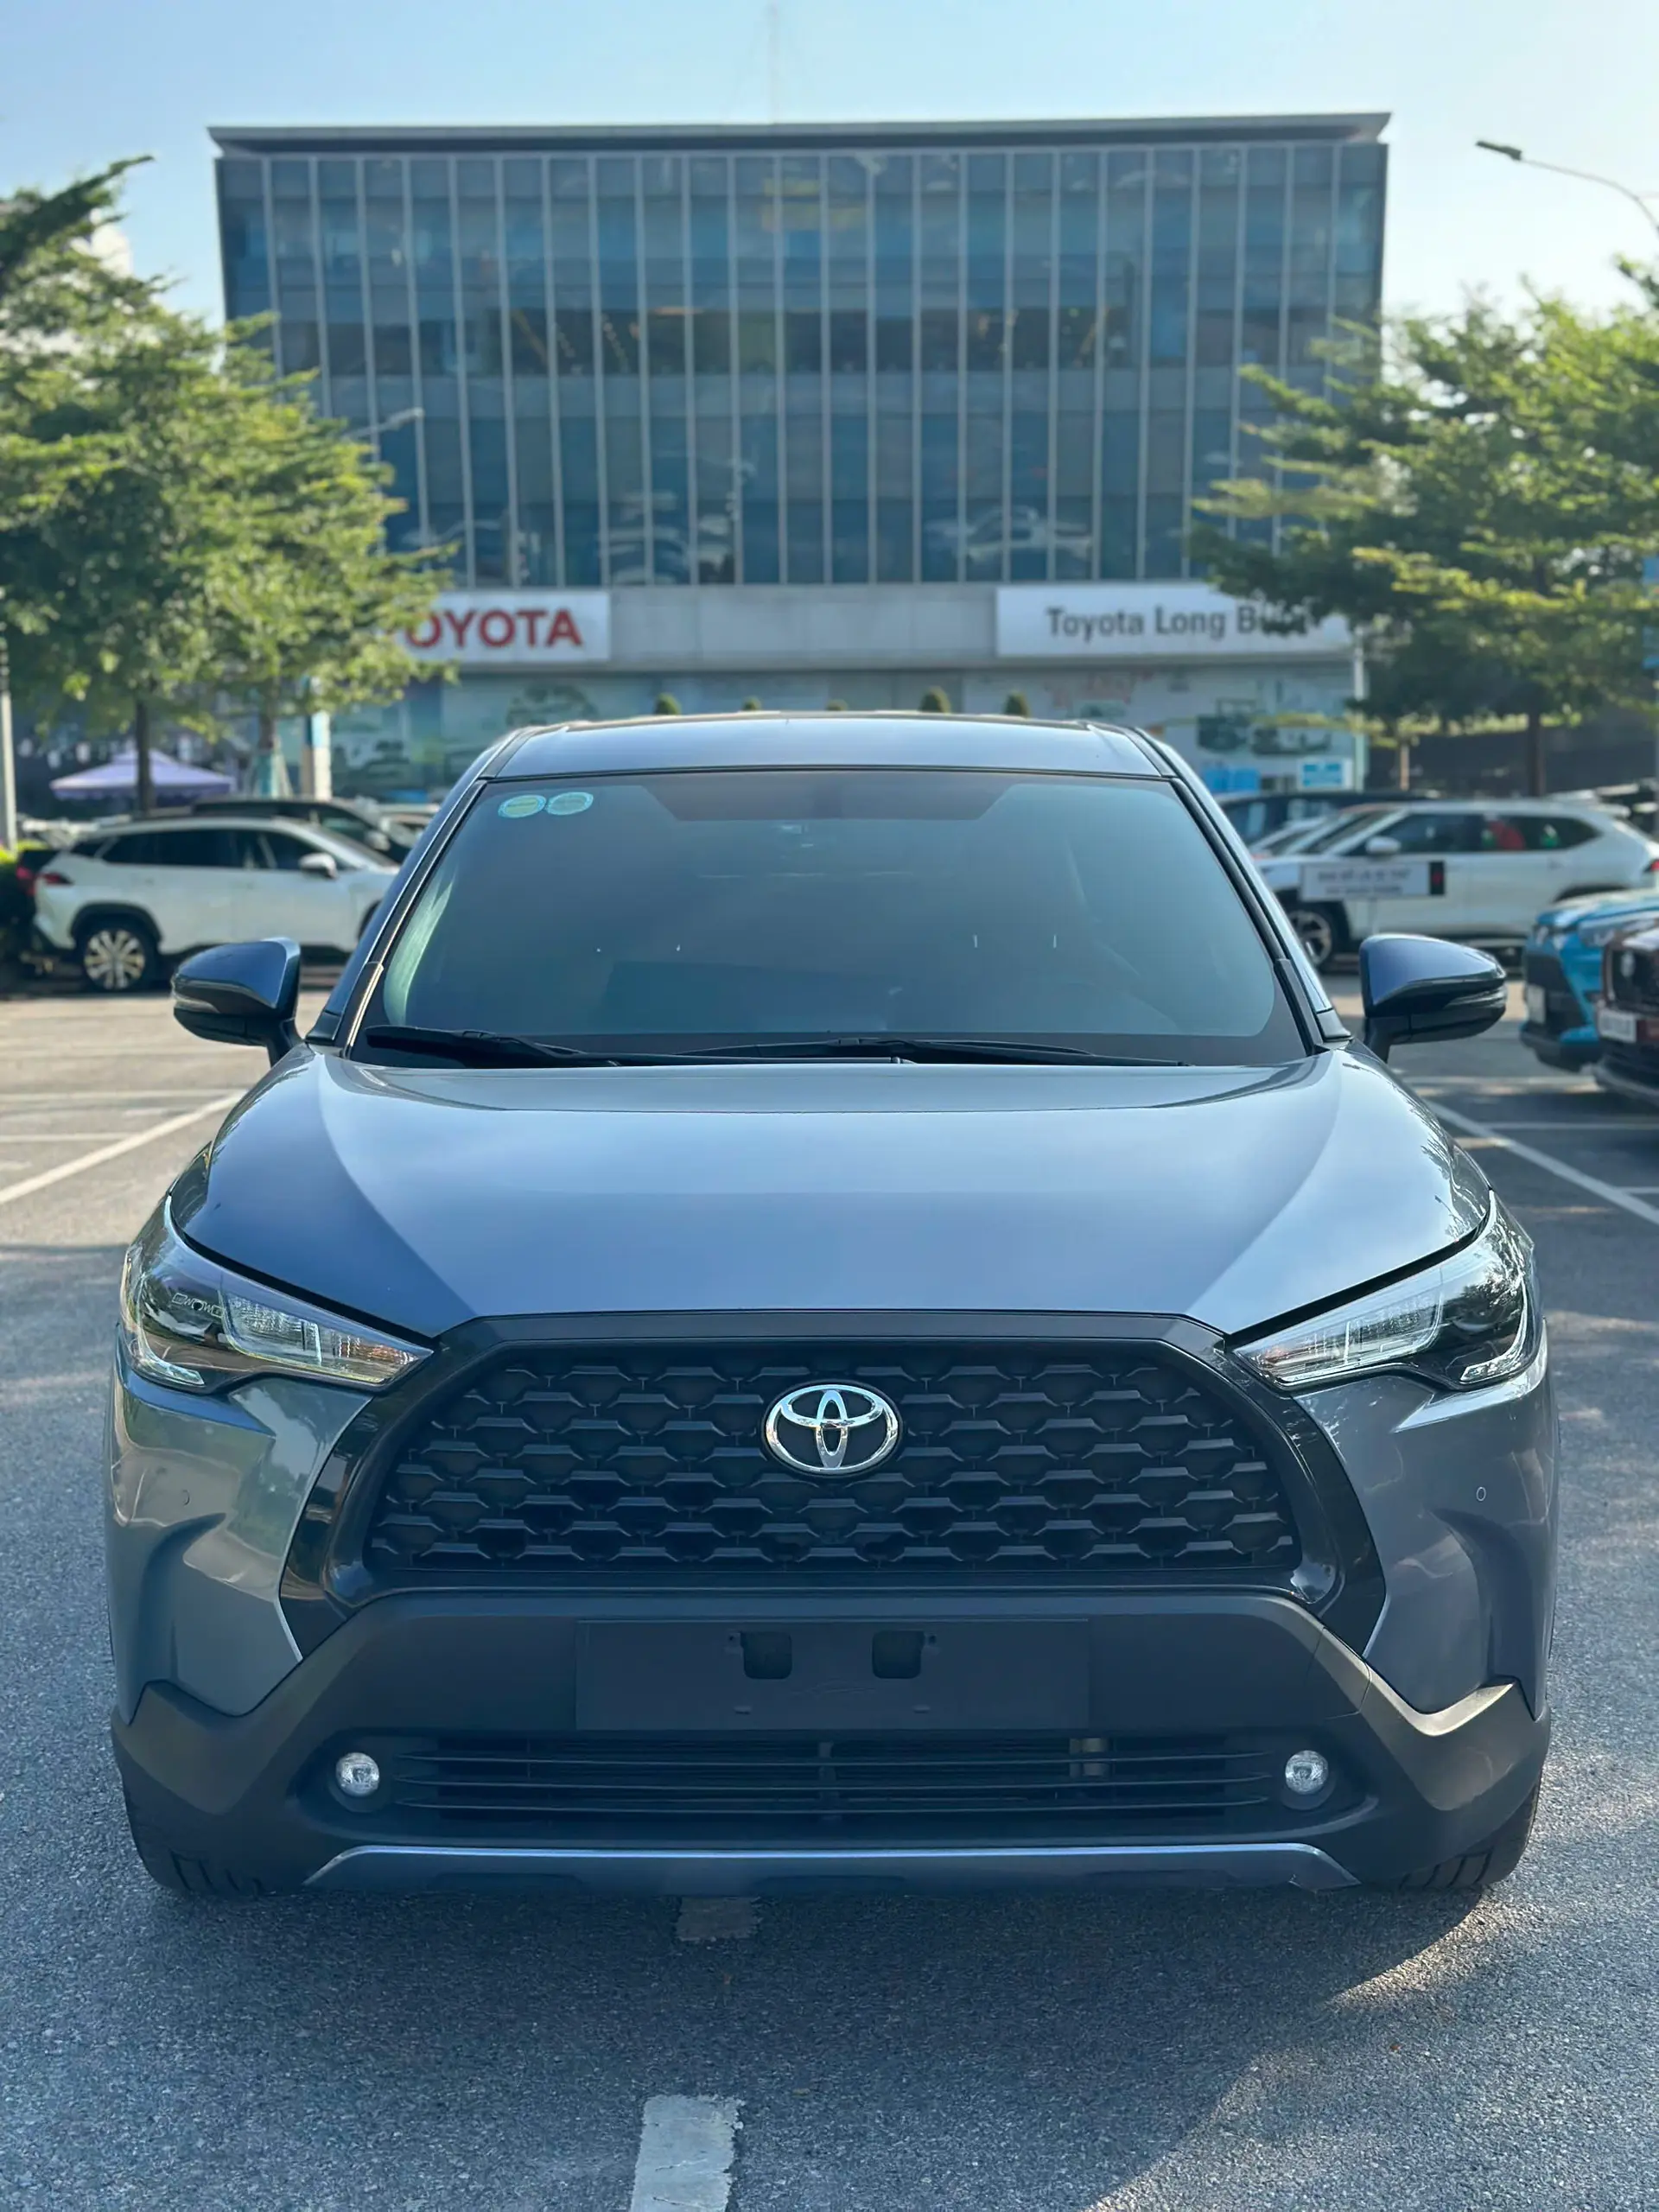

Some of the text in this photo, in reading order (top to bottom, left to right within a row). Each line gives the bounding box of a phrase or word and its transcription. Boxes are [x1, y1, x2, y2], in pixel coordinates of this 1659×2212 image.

[377, 608, 584, 648] OYOTA
[1046, 606, 1145, 642] Toyota
[1154, 605, 1226, 640] Long
